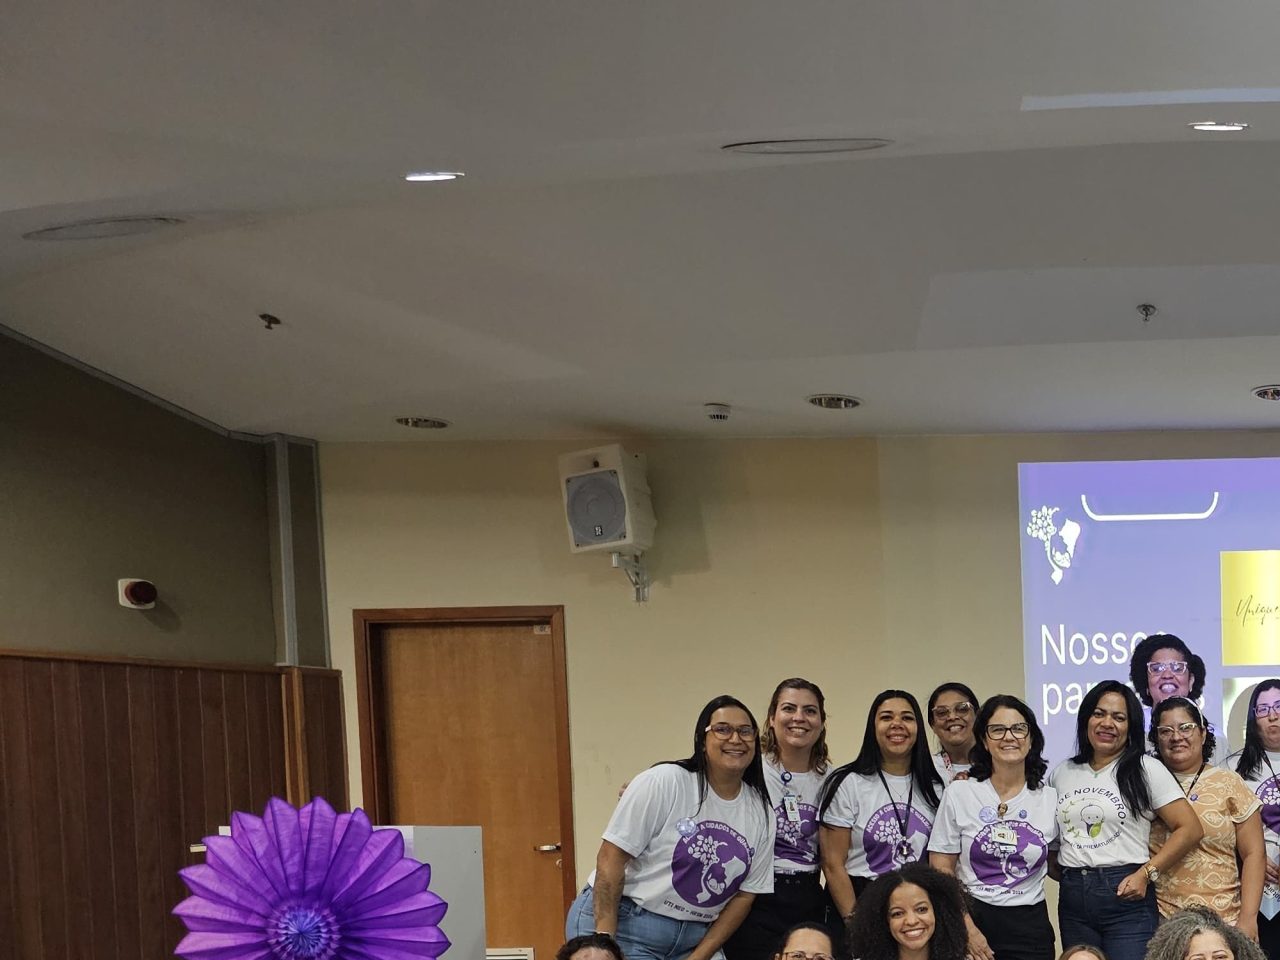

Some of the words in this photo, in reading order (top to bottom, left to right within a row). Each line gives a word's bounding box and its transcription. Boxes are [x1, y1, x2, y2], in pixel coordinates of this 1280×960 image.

[1236, 594, 1279, 628] Unique
[1058, 792, 1072, 805] DE
[1074, 787, 1127, 819] NOVEMBRO
